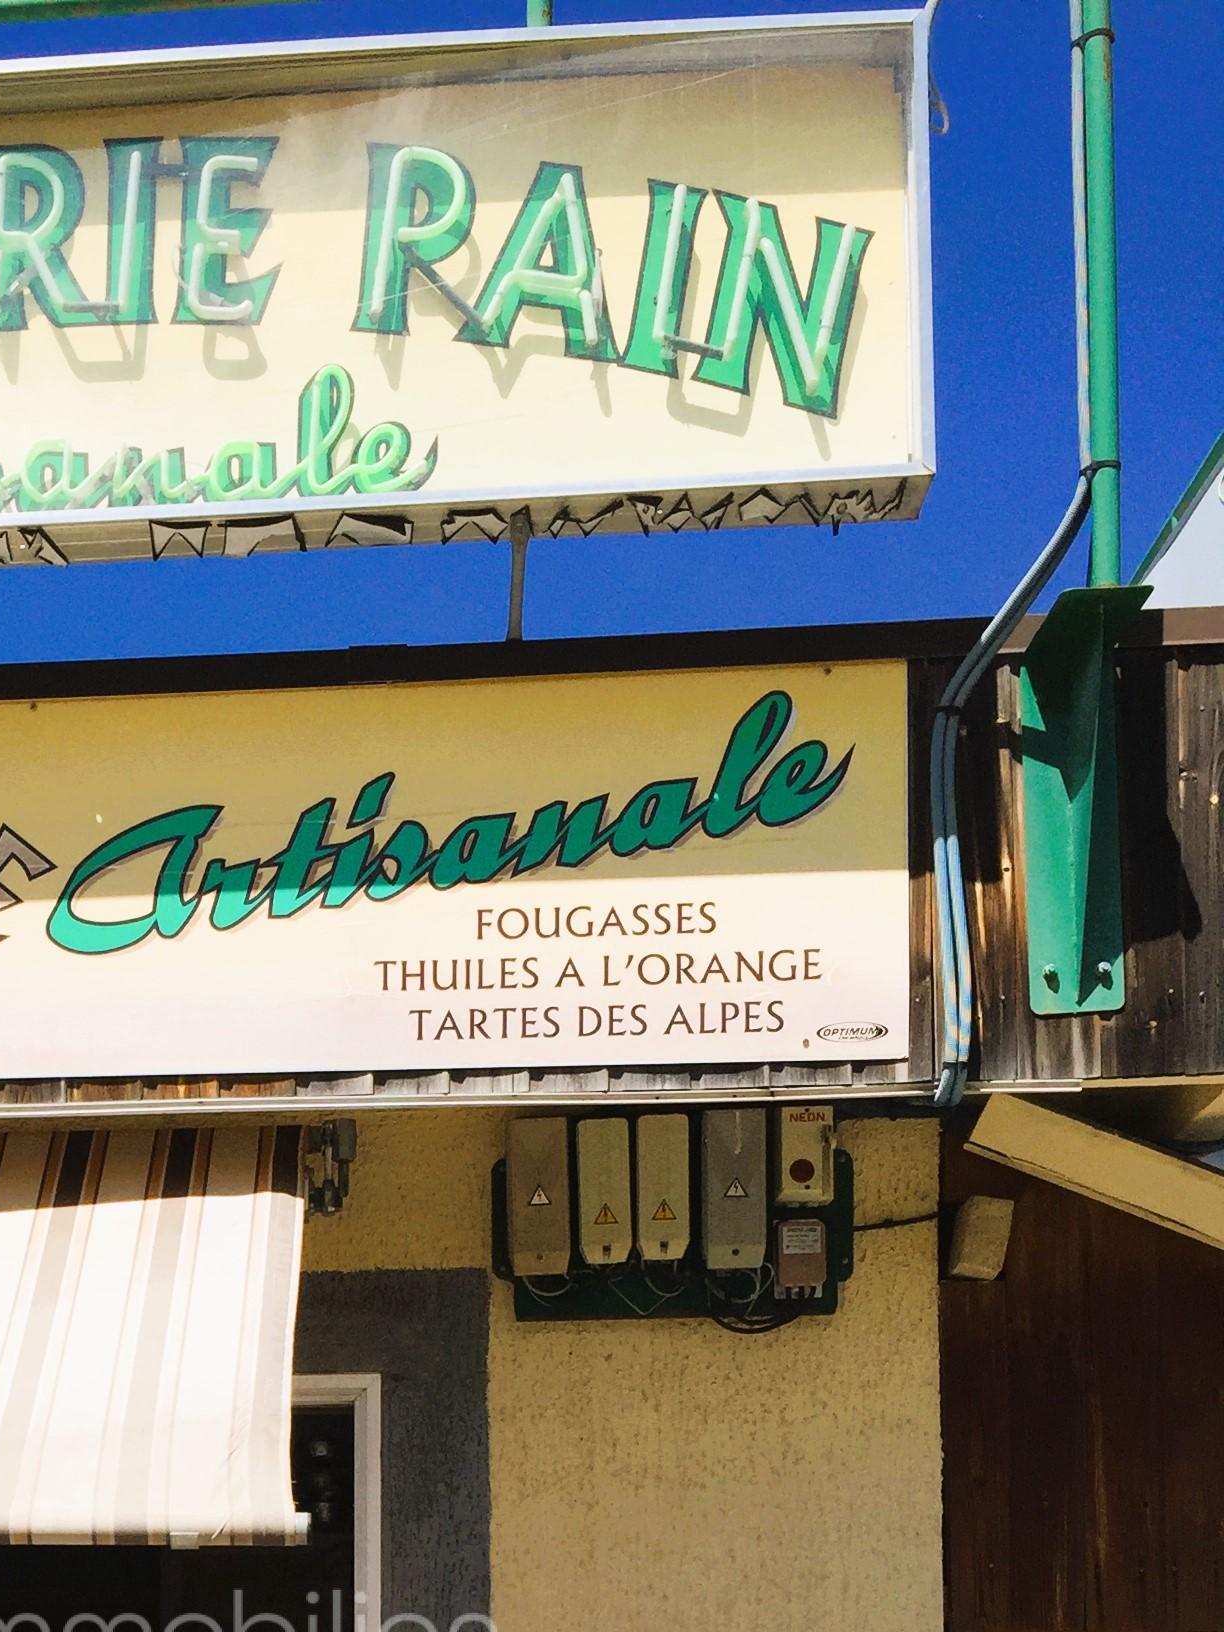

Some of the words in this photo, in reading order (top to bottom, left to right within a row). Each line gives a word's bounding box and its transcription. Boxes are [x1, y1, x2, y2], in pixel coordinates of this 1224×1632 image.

[351, 143, 875, 419] PAIN
[46, 689, 856, 955] Artisanale
[476, 901, 718, 940] FOUGASSES
[374, 956, 540, 992] THUILES
[555, 957, 586, 988] A
[602, 948, 823, 987] L'ORANGE
[409, 1006, 561, 1041] TARTES
[577, 1003, 649, 1037] DES
[664, 1000, 786, 1035] ALPES
[823, 1027, 878, 1037] OPTIMUM
[789, 1111, 826, 1123] NEON
